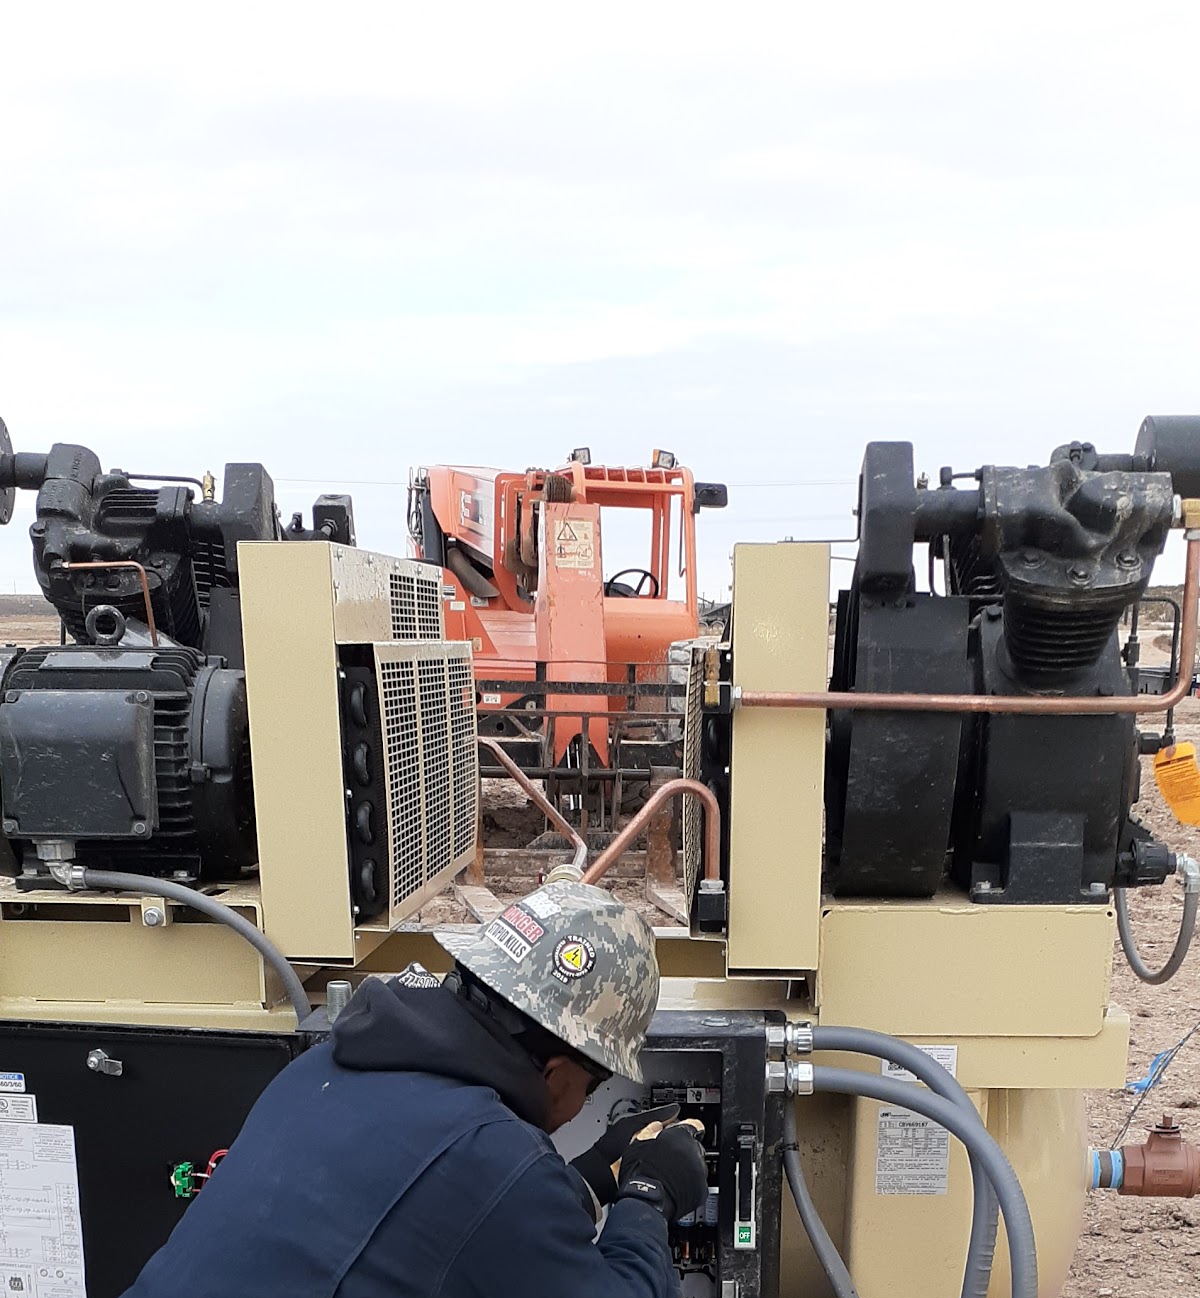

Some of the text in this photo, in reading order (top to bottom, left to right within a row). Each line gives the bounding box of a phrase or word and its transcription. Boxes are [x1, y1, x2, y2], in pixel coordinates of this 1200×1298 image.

[502, 905, 545, 944] DANGER
[488, 921, 527, 959] STUPID KILLS
[567, 935, 595, 958] TRAINED
[552, 969, 569, 984] 2019
